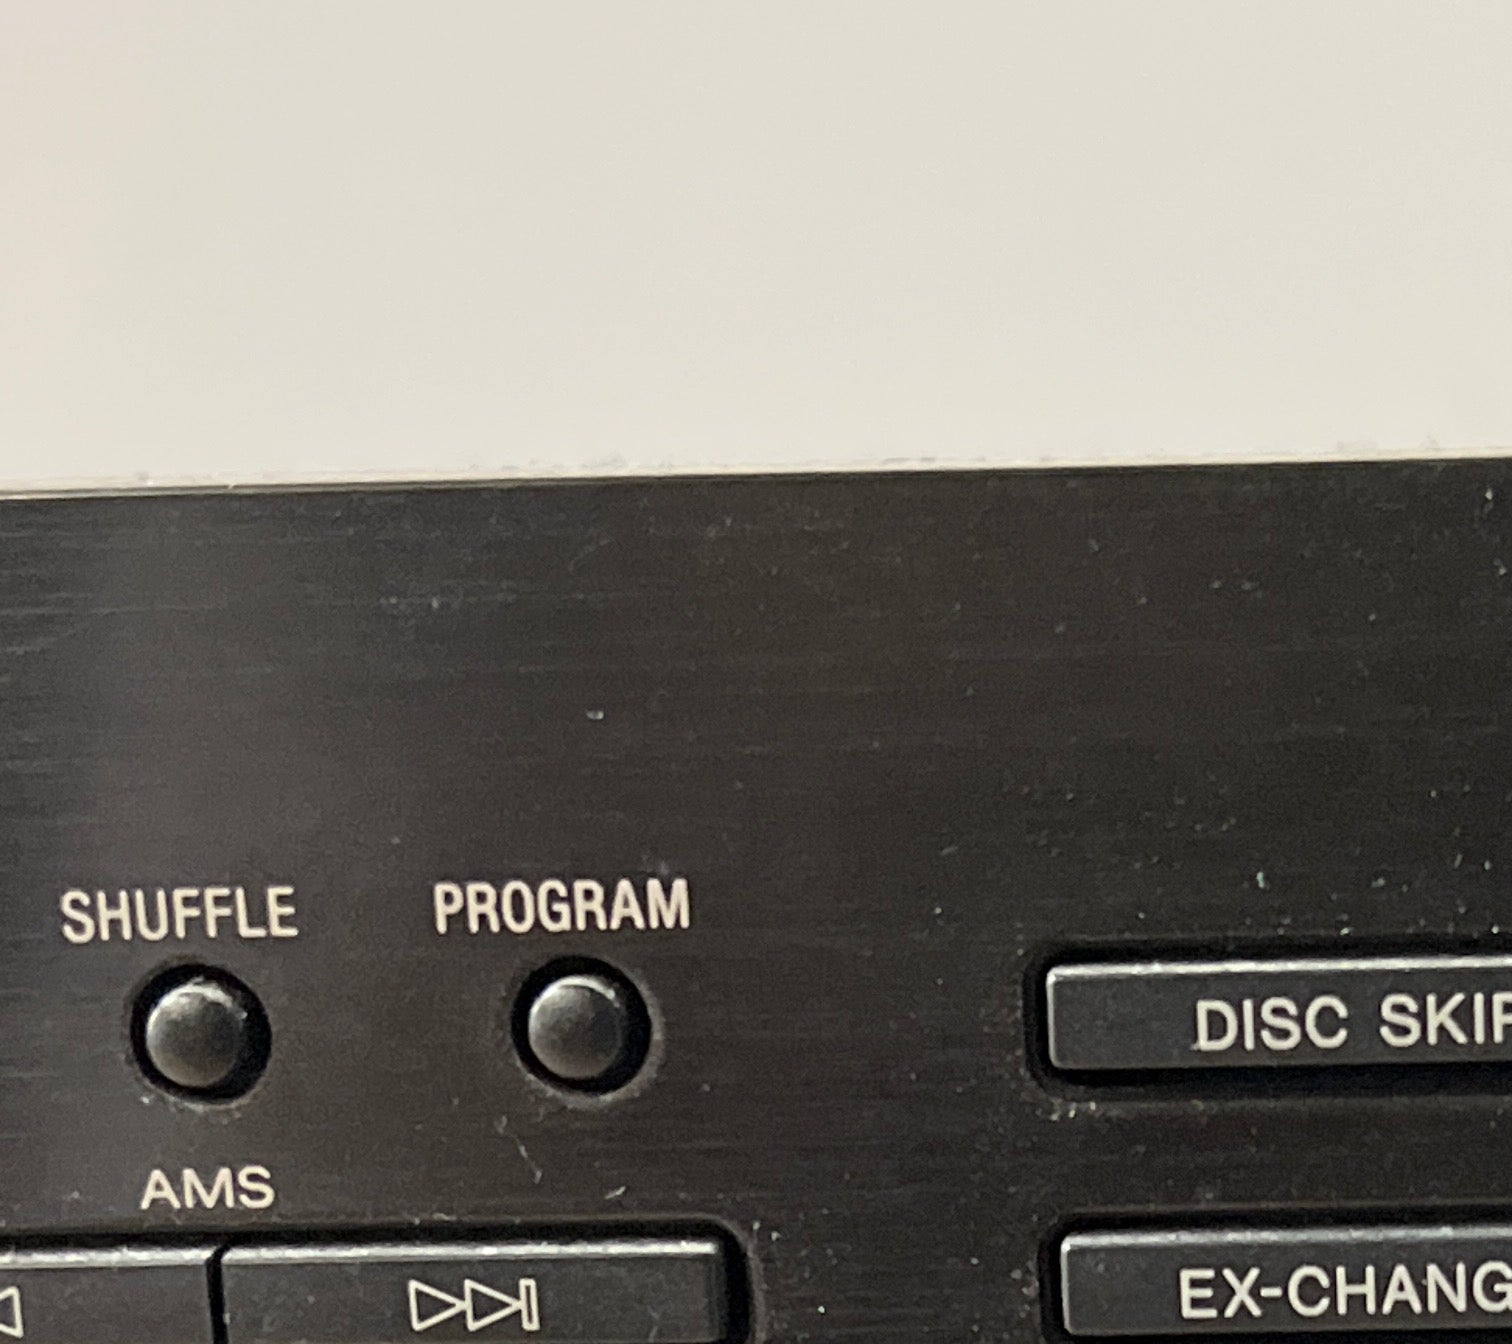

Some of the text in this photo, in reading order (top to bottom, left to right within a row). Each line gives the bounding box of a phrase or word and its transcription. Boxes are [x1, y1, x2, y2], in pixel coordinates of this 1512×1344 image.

[60, 886, 299, 943] SHUFFLE
[434, 879, 691, 934] PROGRAM
[1195, 996, 1349, 1051] DISC
[140, 1166, 275, 1209] AMS
